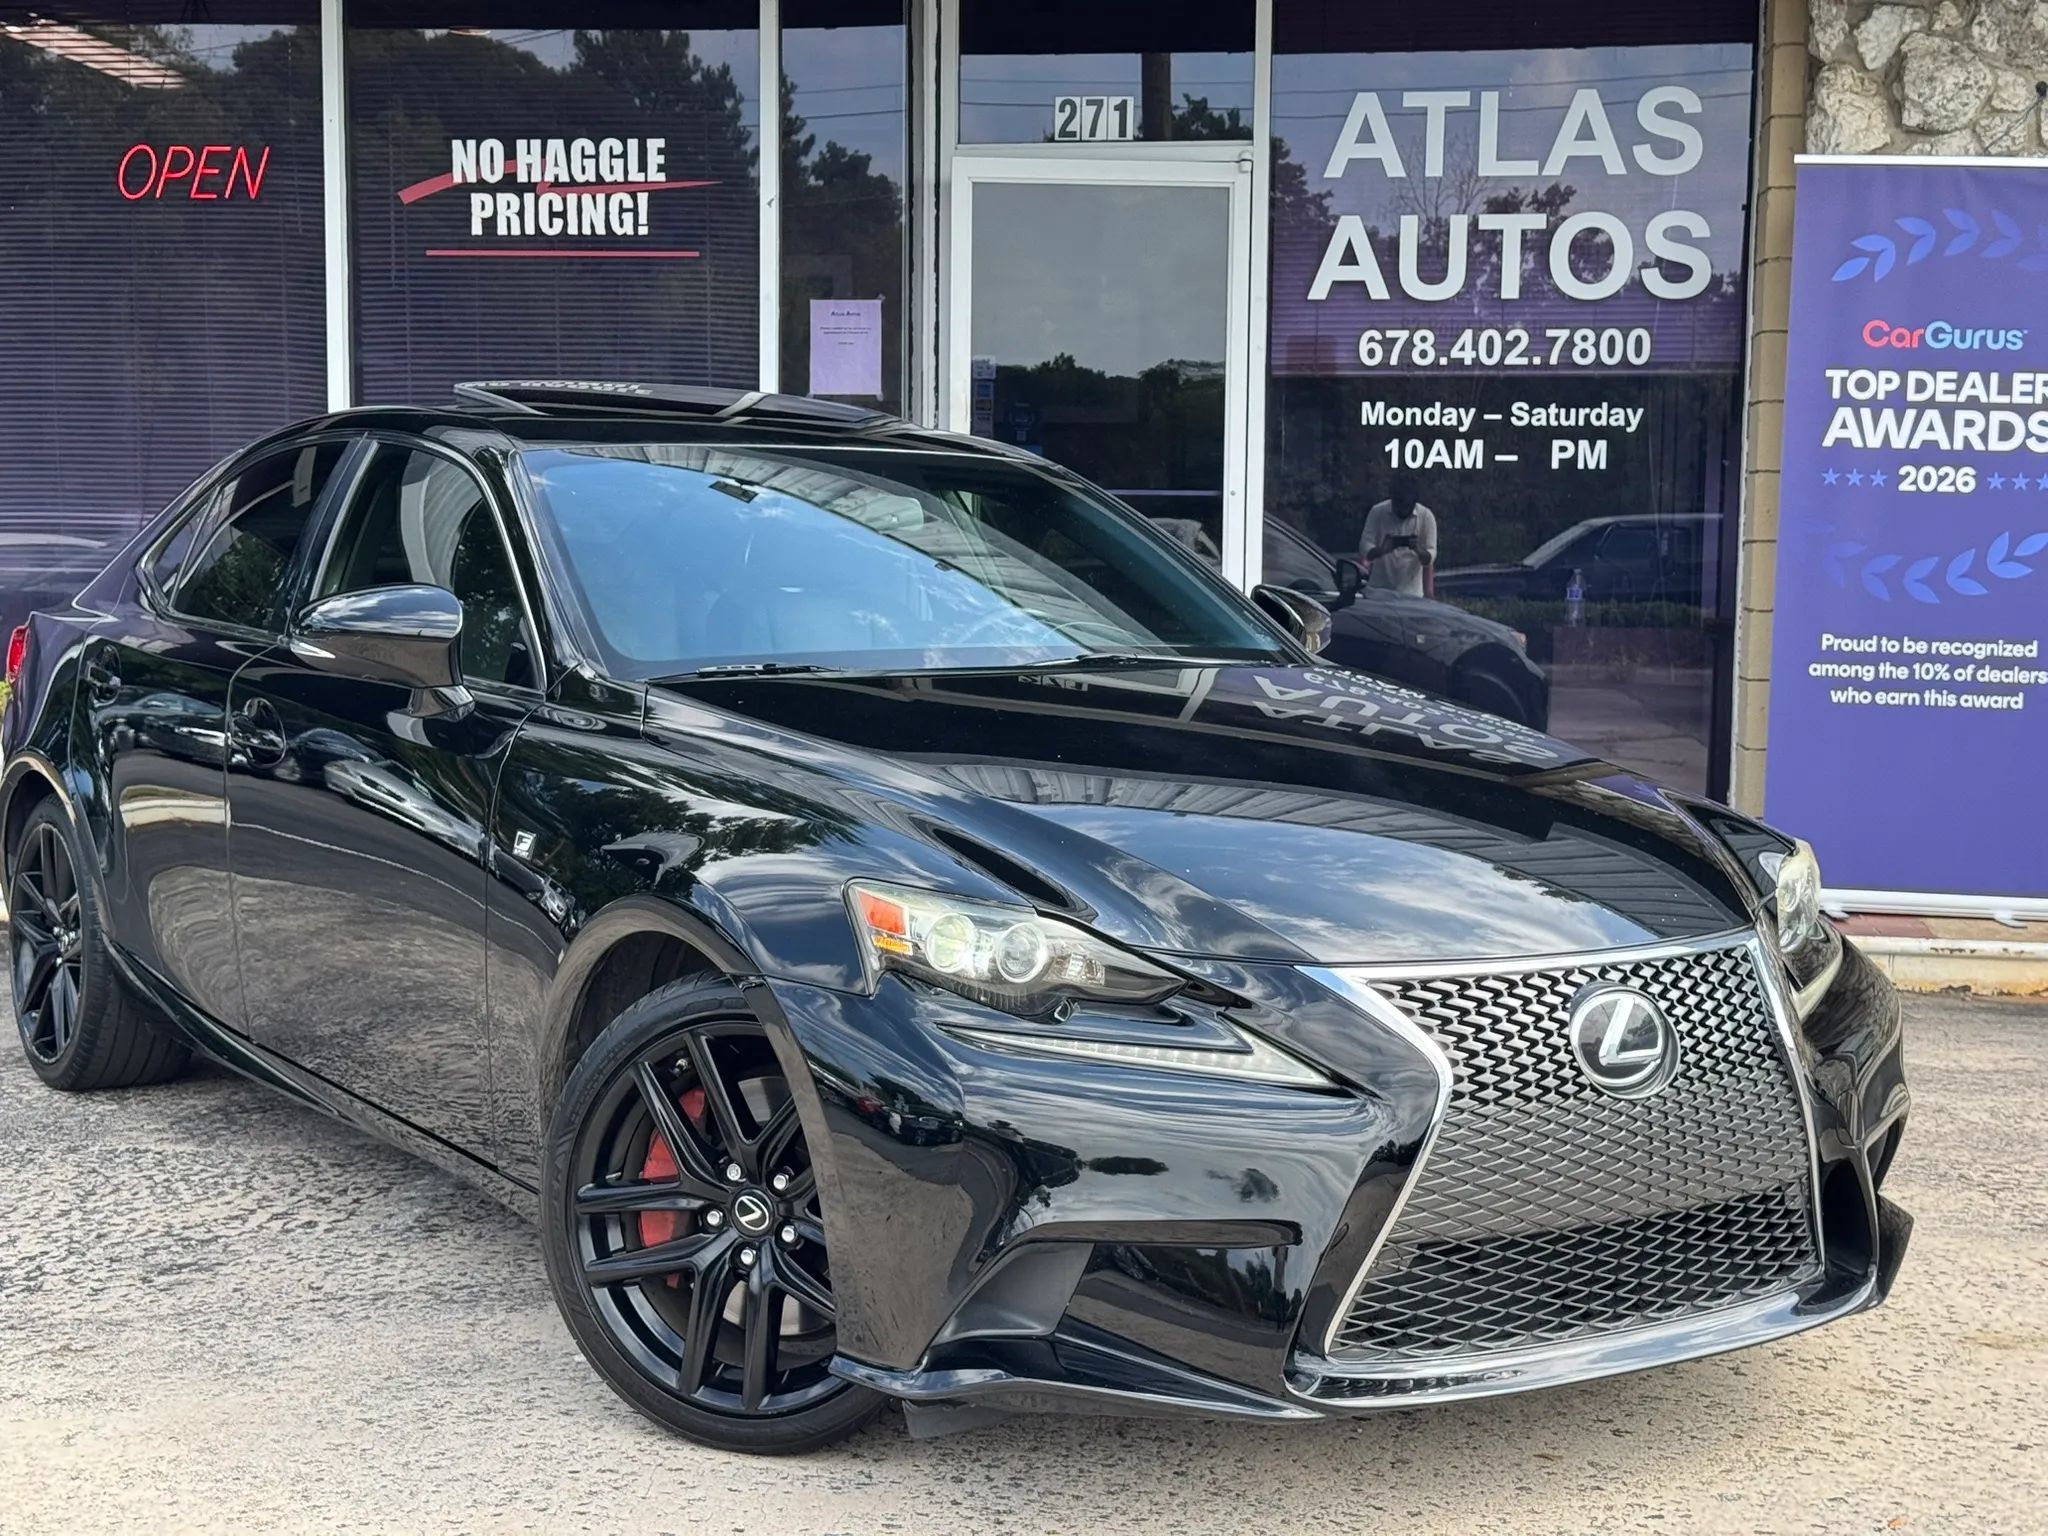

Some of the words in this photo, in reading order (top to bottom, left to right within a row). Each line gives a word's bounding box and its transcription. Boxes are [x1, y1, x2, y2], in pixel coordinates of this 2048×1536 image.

[1058, 98, 1128, 138] 271
[1323, 86, 1703, 178] ATLAS
[116, 143, 270, 201] OPEN
[451, 138, 505, 184] NO
[516, 138, 667, 183] HAGGLE
[470, 192, 650, 237] PRICING!
[1307, 210, 1712, 301] AUTOS
[1358, 328, 1652, 366] 678.402.7800
[1862, 319, 2025, 350] CarGurus
[1825, 369, 1901, 400] TOP
[1361, 401, 1476, 433] Monday
[1510, 401, 1644, 433] Saturday
[1821, 406, 2048, 453] AWARDS
[1384, 438, 1484, 470] 10AM
[1551, 439, 1607, 470] PM
[1897, 464, 1977, 493] 2026
[1821, 633, 1877, 653] Proud
[1880, 636, 1900, 653] to
[1903, 636, 1928, 655] be
[1931, 639, 2038, 660] recognized
[1808, 661, 1875, 682] among
[1878, 661, 1909, 680] the
[1912, 662, 1951, 681] 10%
[1953, 664, 1976, 682] of
[1976, 665, 2048, 684] dealers
[1830, 686, 1872, 705] who
[1875, 690, 1920, 706] earn
[1923, 689, 1957, 708] this
[1959, 691, 2025, 710] award
